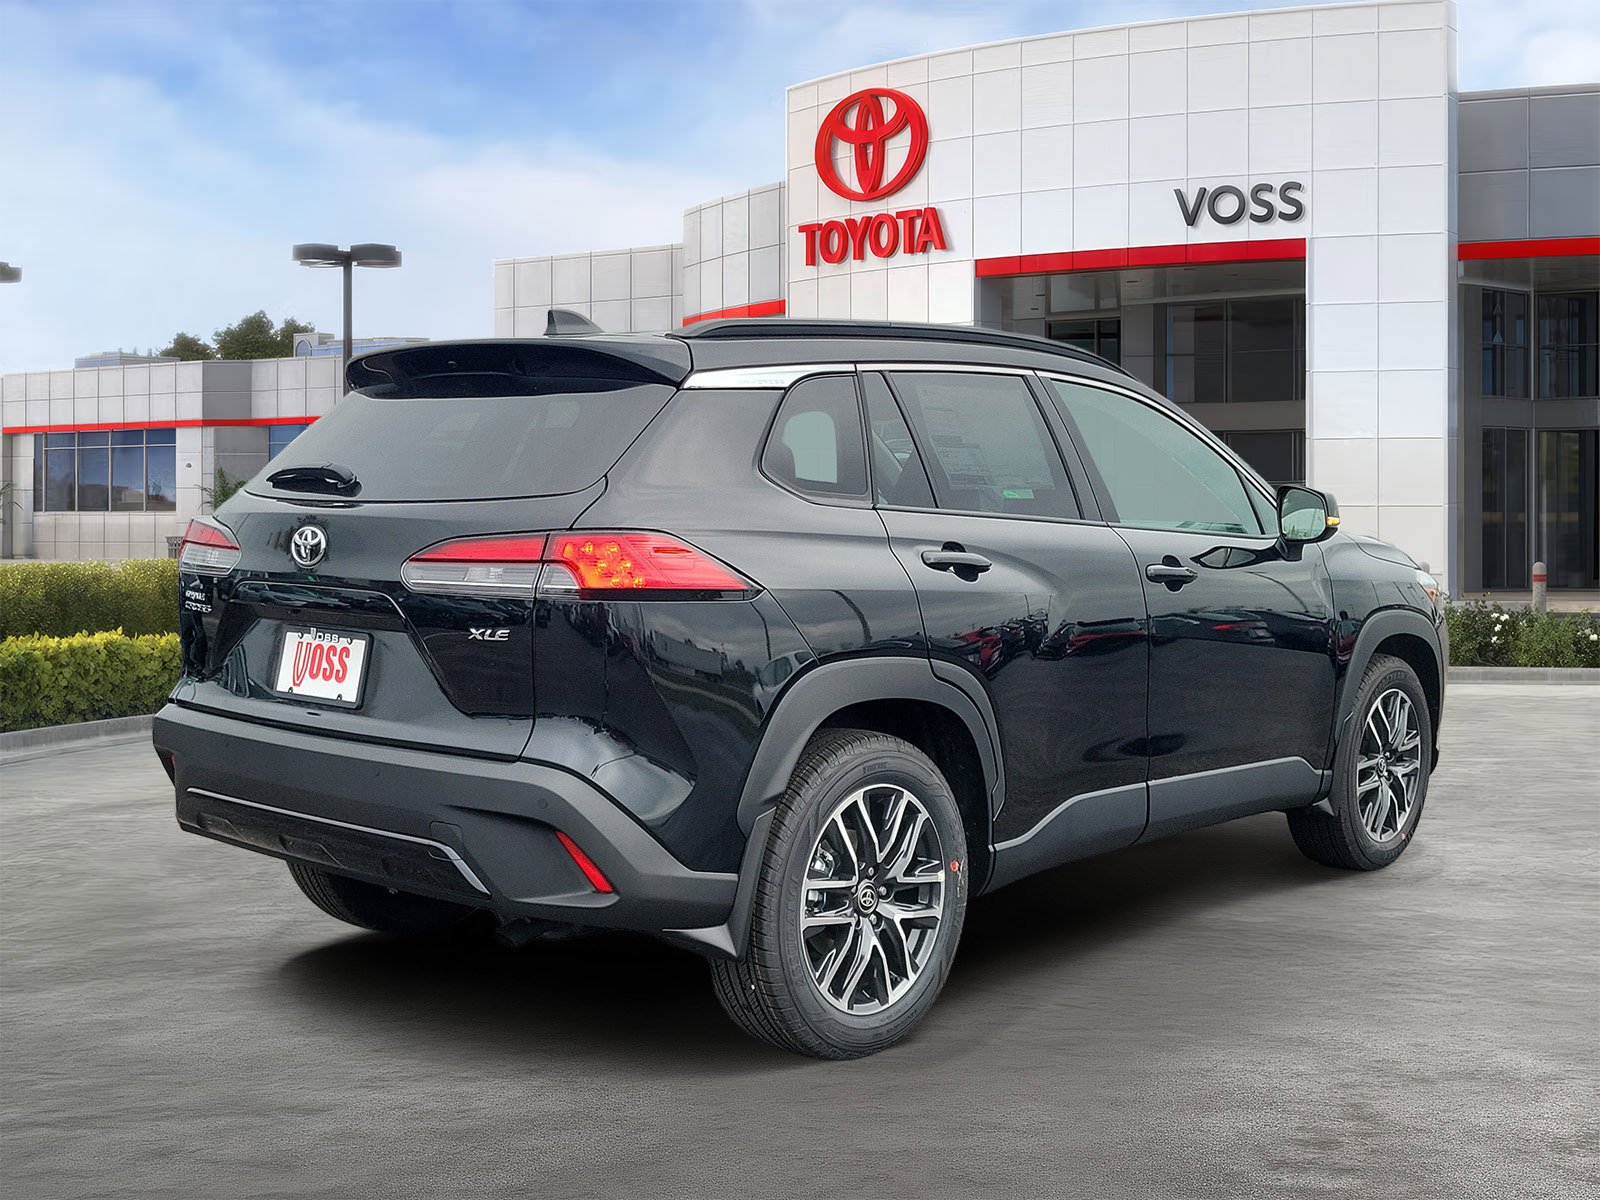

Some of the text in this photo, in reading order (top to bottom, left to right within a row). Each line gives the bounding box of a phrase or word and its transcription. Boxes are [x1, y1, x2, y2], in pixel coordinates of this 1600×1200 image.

[1174, 181, 1306, 227] VOSS
[798, 207, 948, 266] TOYOTA
[468, 628, 510, 641] XLE
[292, 641, 351, 687] VOSS
